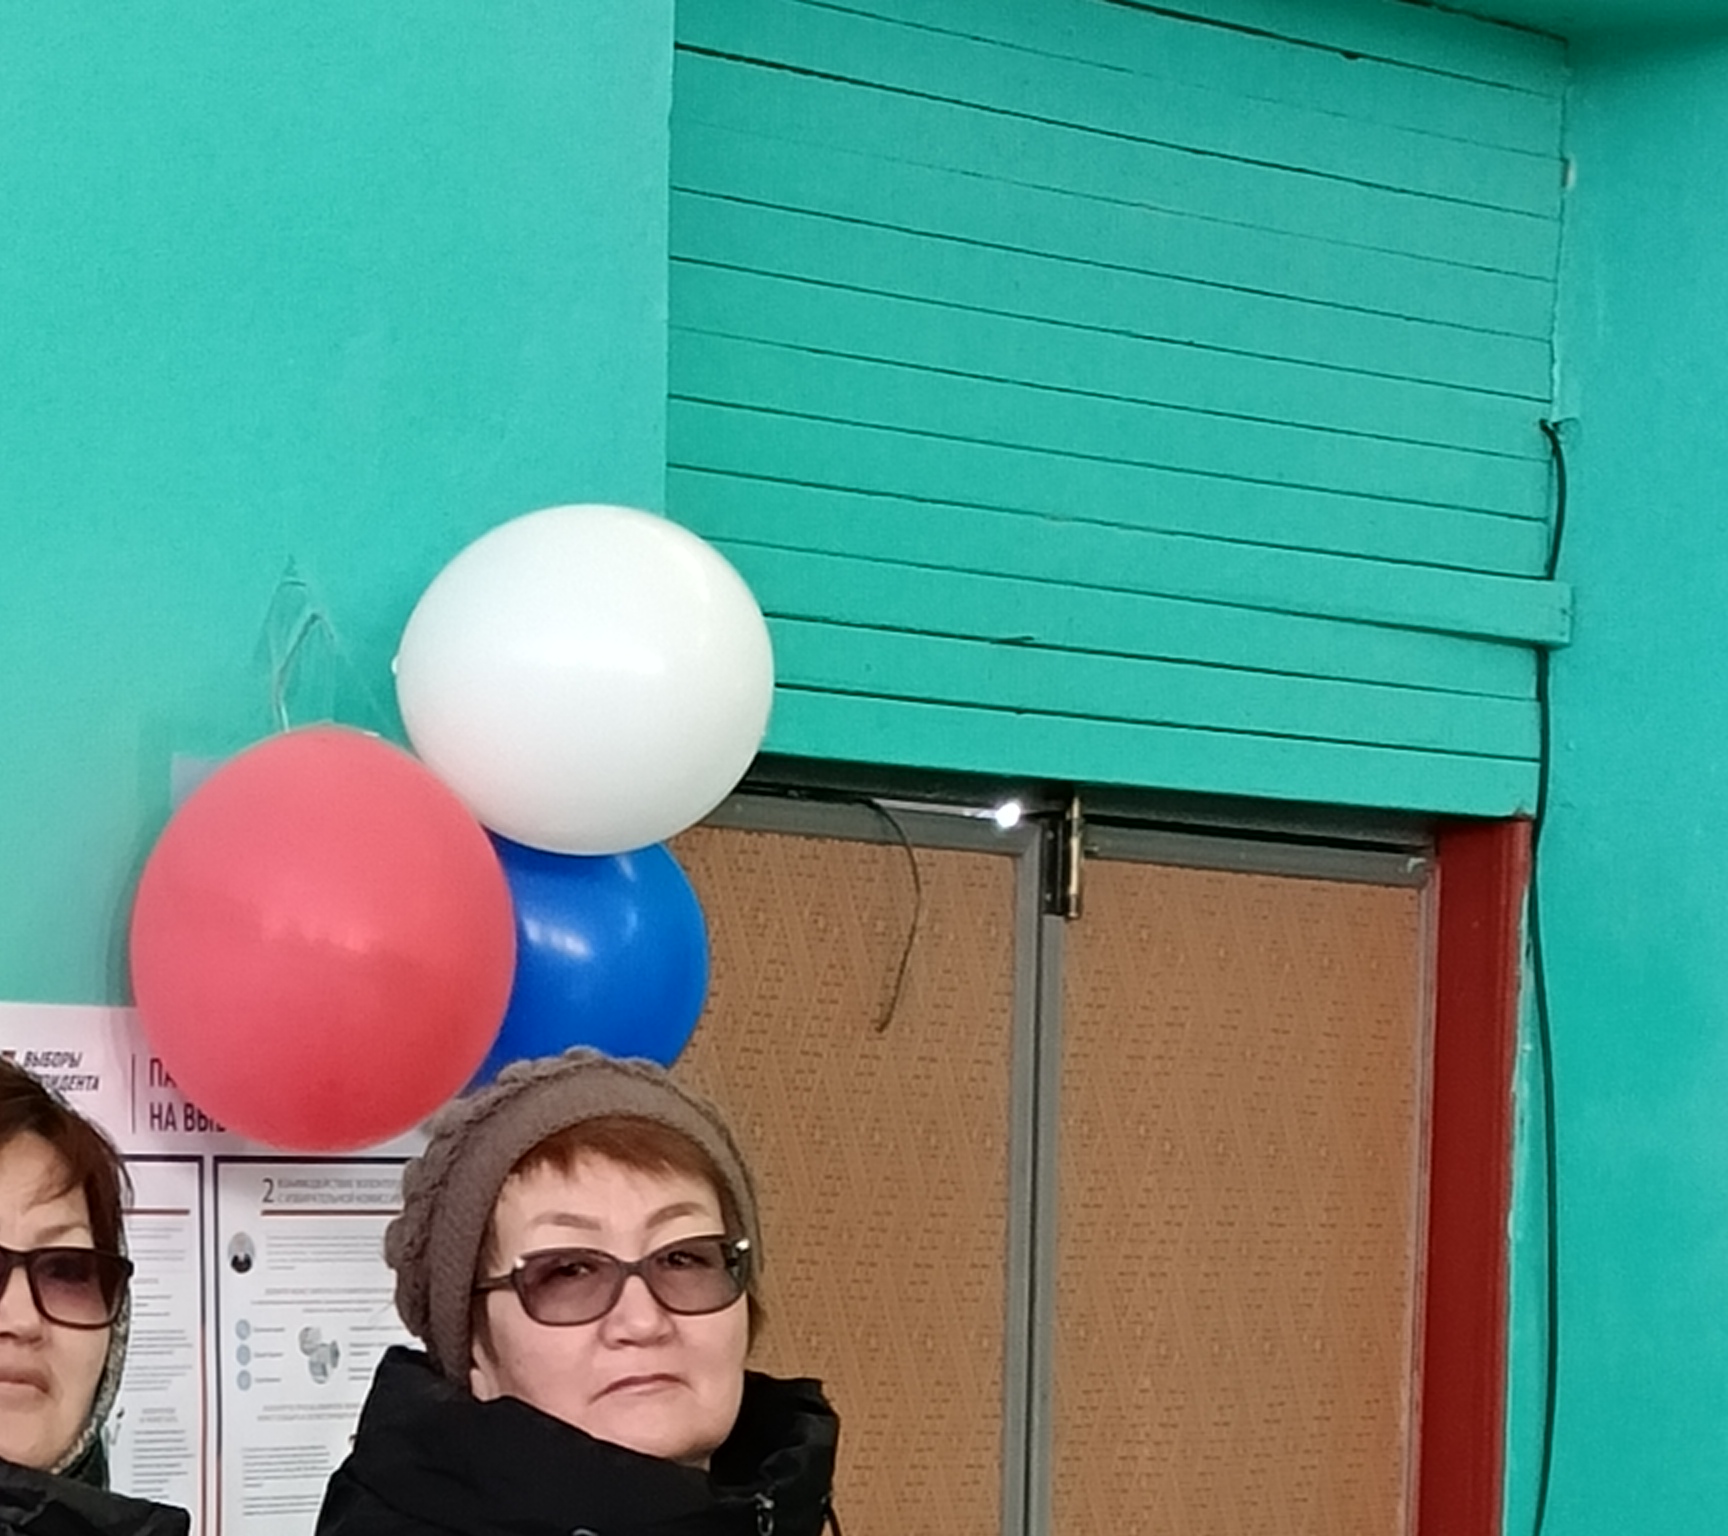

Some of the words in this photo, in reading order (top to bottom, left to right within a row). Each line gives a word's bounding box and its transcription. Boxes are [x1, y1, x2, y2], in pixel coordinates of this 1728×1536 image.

[23, 1051, 82, 1069] ВЫБОРЫ
[149, 1102, 178, 1132] НА
[262, 1177, 274, 1204] 2
